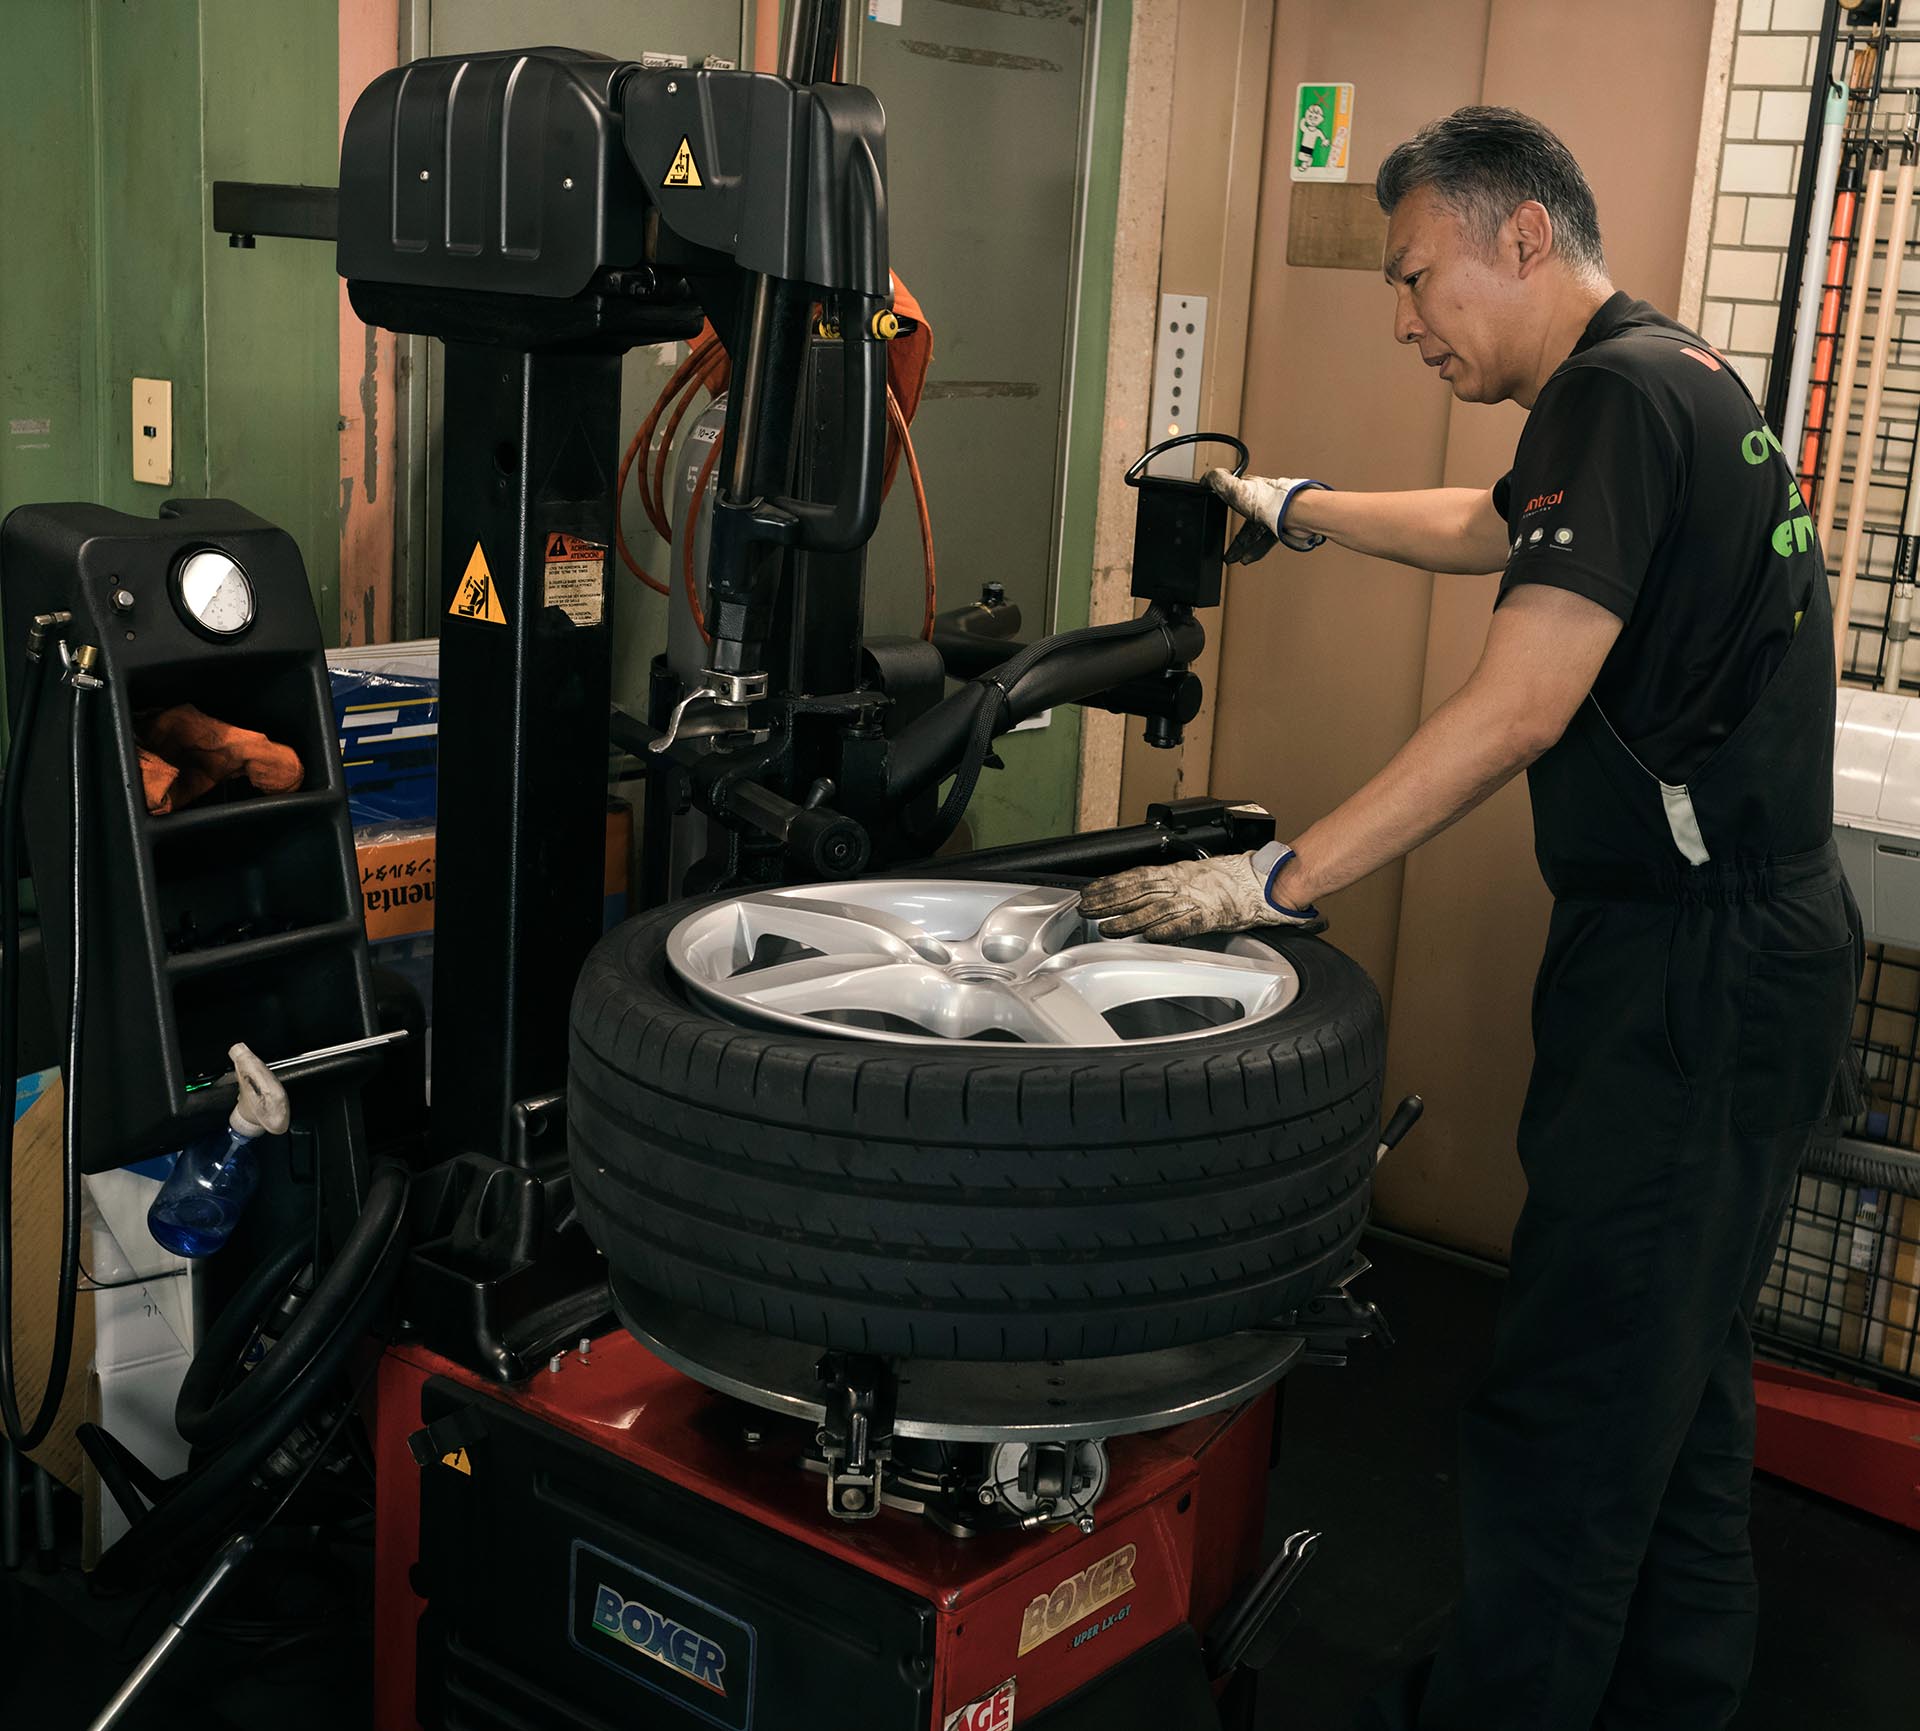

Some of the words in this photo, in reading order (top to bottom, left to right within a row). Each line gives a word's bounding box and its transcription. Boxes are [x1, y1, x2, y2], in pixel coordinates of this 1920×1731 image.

[362, 858, 433, 884] ンタルタイ
[1018, 1544, 1136, 1655] BOXER
[593, 1584, 727, 1694] BOXER
[1070, 1623, 1099, 1650] UPER
